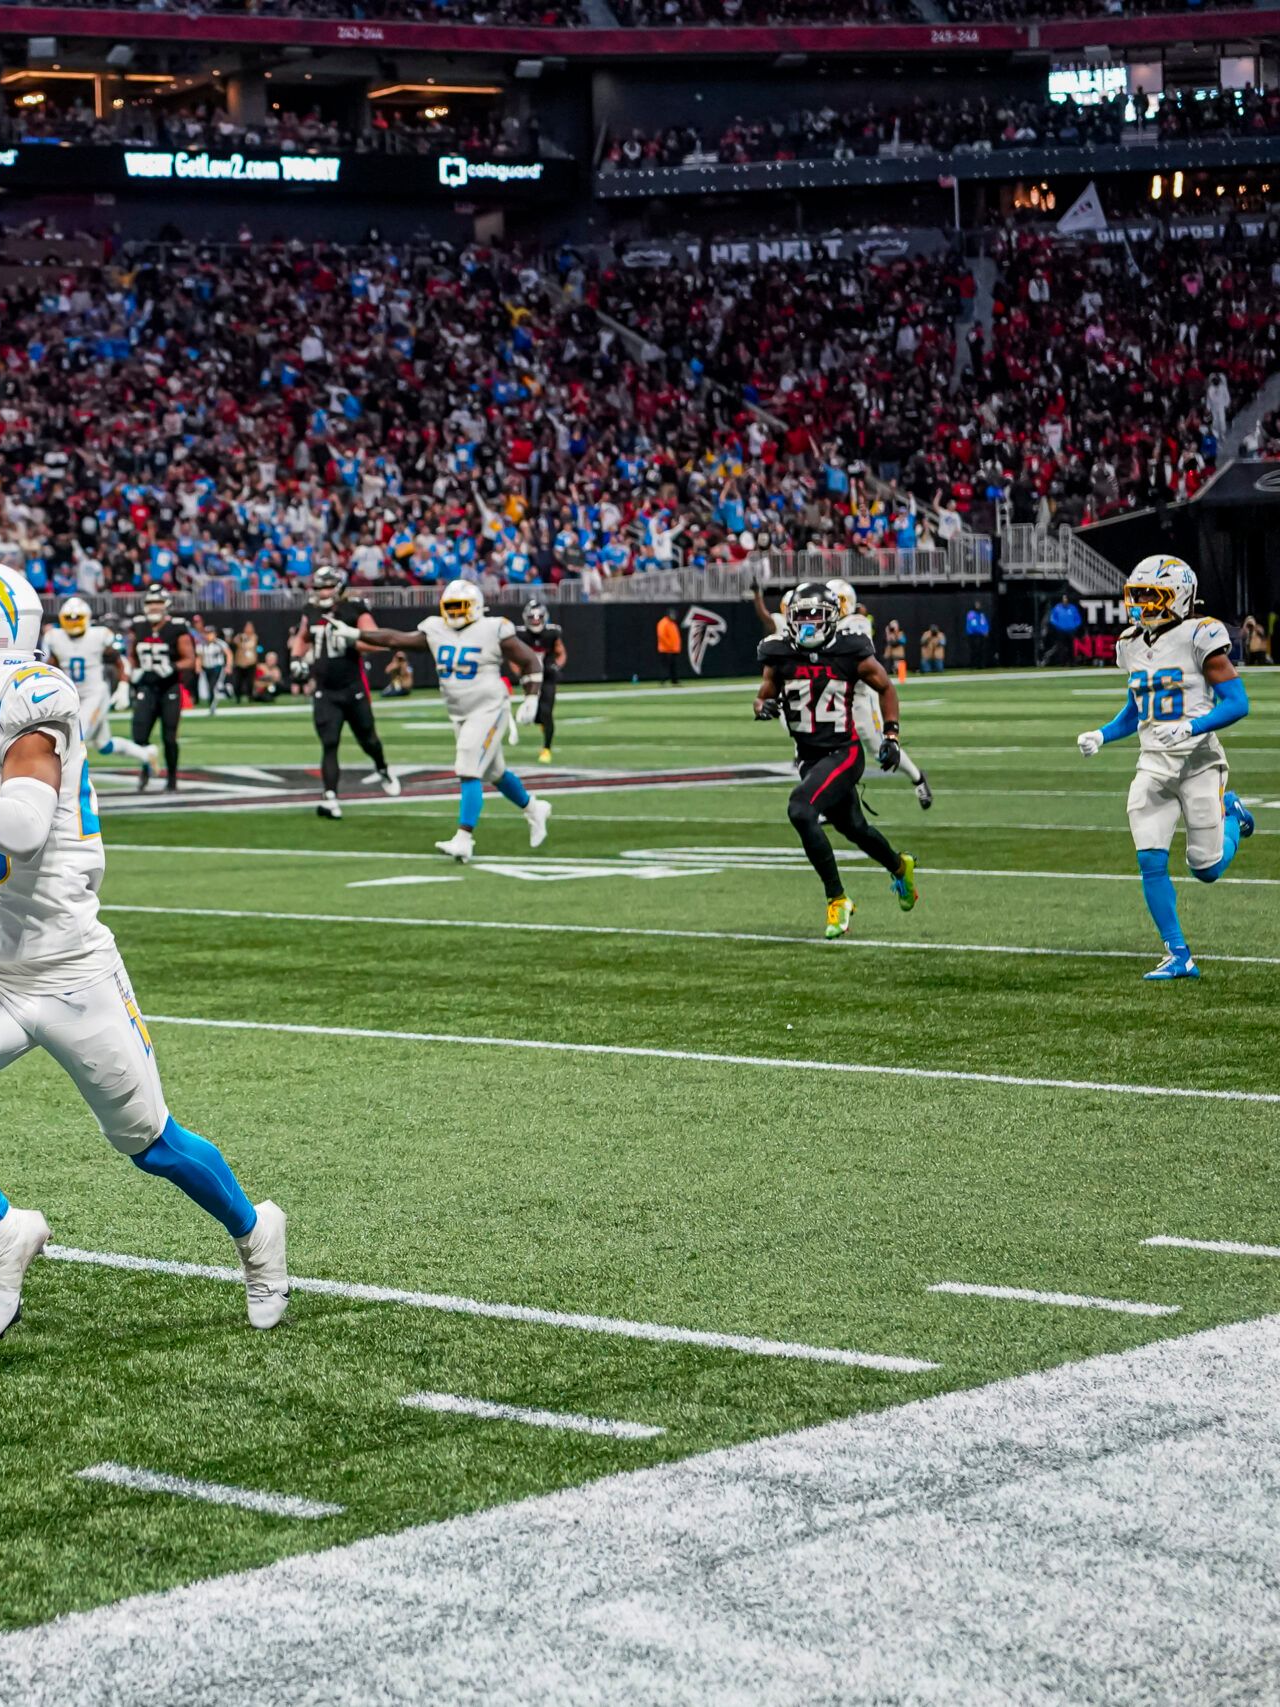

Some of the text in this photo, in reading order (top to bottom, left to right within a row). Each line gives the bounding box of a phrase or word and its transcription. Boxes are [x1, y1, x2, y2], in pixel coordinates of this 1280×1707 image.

[280, 157, 340, 181] TODAY
[1080, 600, 1129, 624] TH
[1073, 634, 1118, 658] NE
[436, 645, 482, 680] 95
[795, 666, 838, 679] ATL
[785, 679, 849, 732] 34
[1129, 667, 1185, 721] 36
